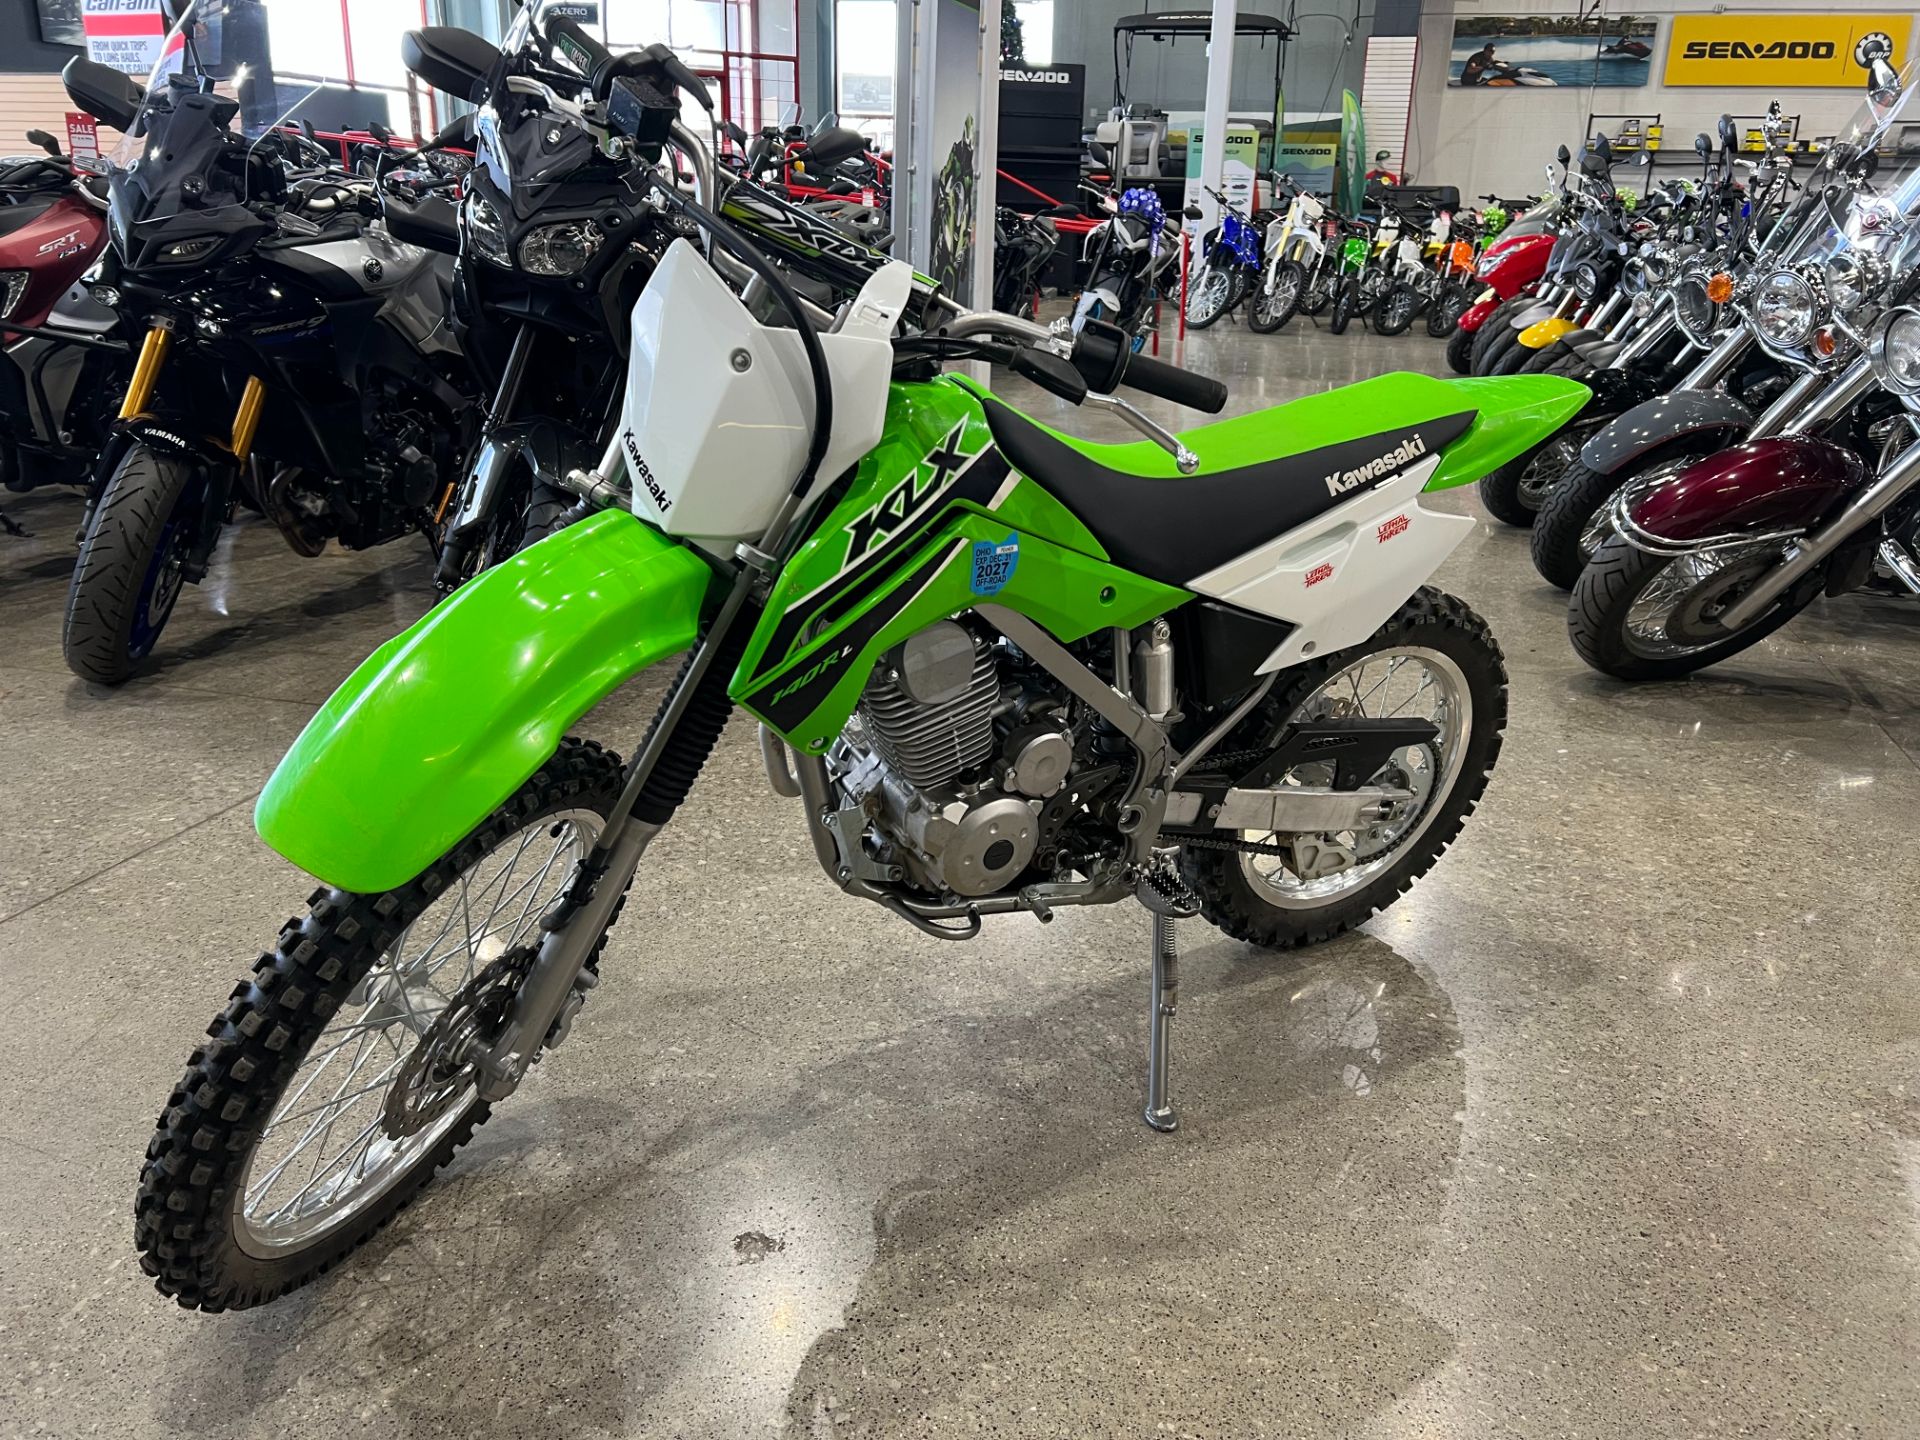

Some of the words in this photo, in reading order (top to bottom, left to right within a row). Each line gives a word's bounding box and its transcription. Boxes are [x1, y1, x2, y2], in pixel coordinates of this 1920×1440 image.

[69, 123, 94, 134] SALE
[35, 229, 80, 257] SRT
[144, 428, 186, 448] YAMAHA
[624, 427, 672, 513] Kawasaki
[1324, 433, 1426, 497] Kawasaki
[840, 411, 977, 574] KLX
[976, 547, 991, 557] OHIO
[977, 562, 1009, 578] 2027
